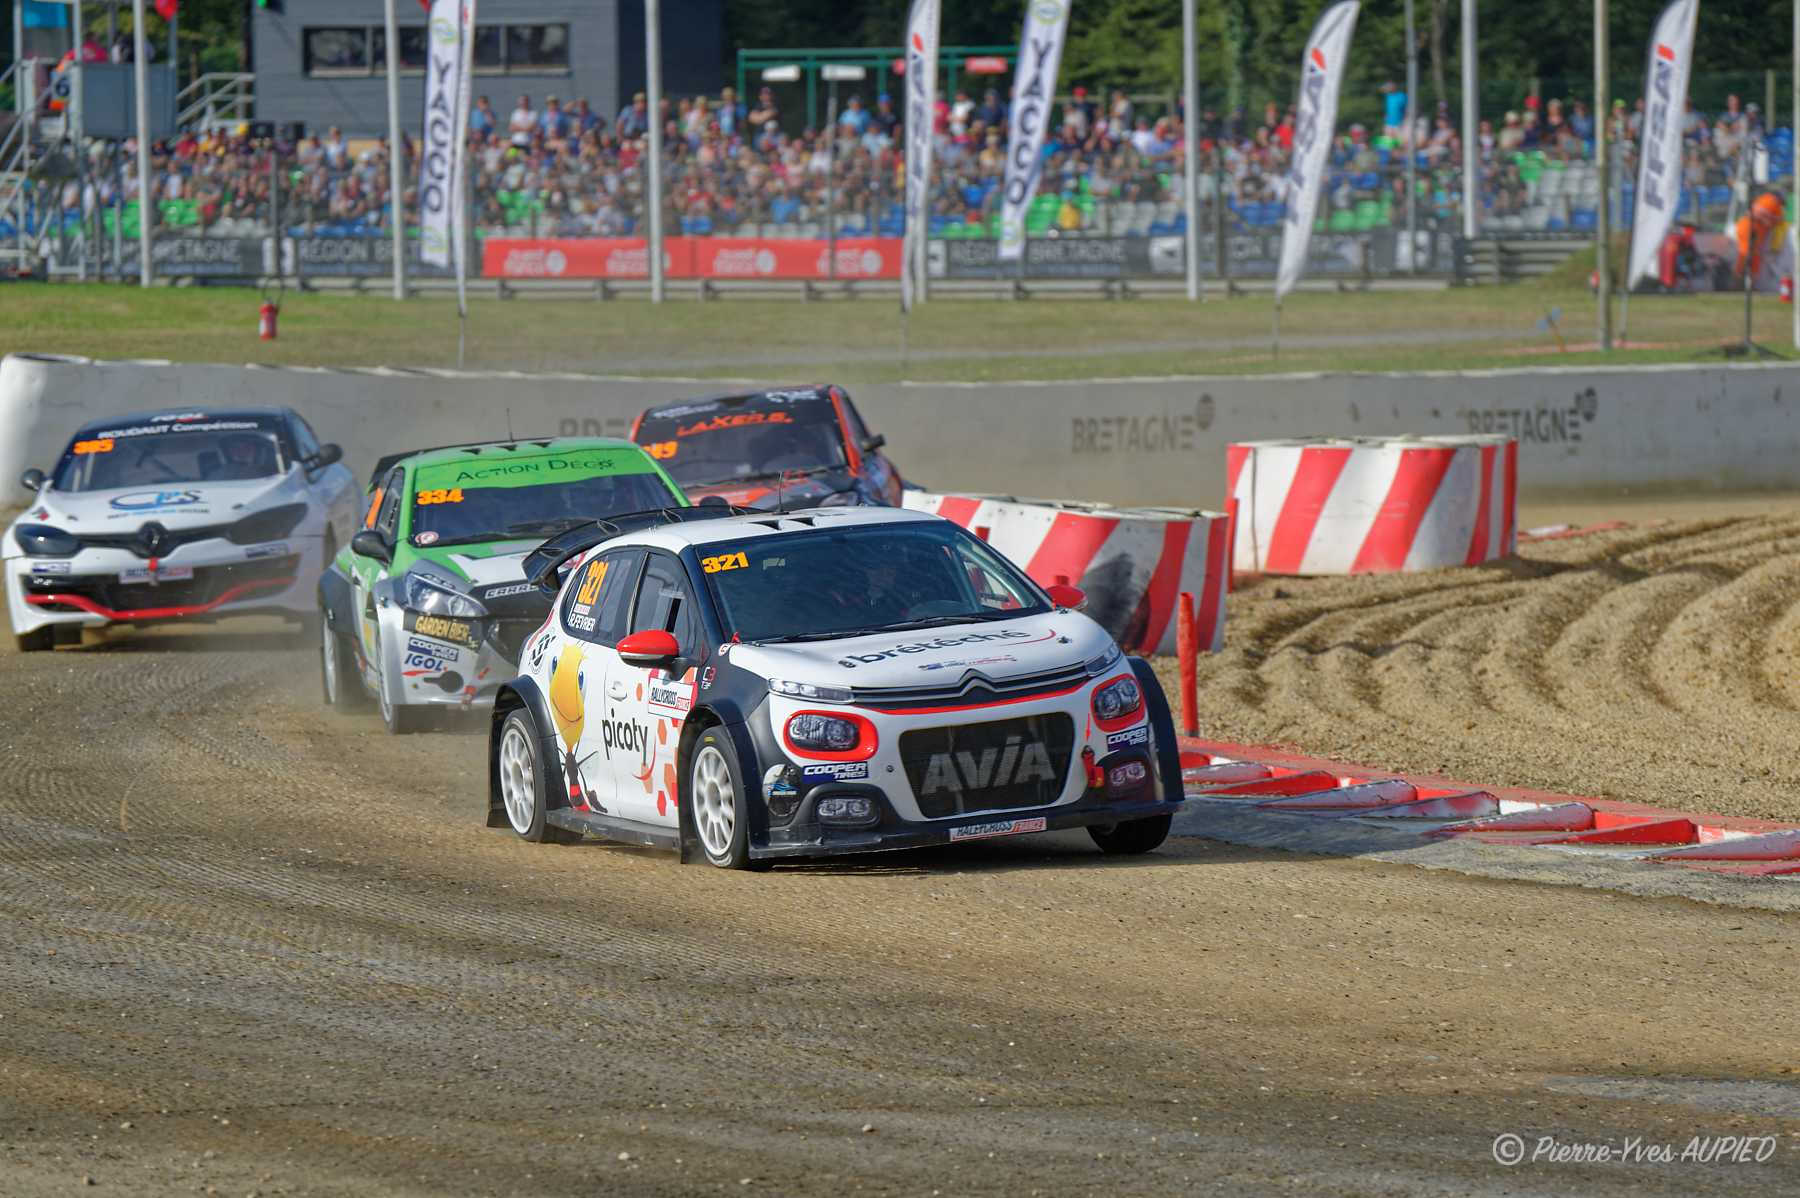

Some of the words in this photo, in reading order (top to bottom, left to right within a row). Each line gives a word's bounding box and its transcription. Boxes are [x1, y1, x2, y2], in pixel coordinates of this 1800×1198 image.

[1006, 37, 1053, 205] YACCO
[424, 54, 453, 214] YACCO
[1071, 415, 1194, 453] BRETAGNE
[456, 463, 540, 482] ACTION
[416, 488, 465, 506] 334
[702, 552, 749, 574] 321
[577, 559, 609, 606] 321
[850, 630, 1031, 664] brétéché
[651, 687, 678, 706] RALLYCROSS
[602, 707, 648, 767] picoty
[1107, 726, 1148, 745] COOPER
[804, 762, 867, 776] COOPER
[833, 770, 866, 780] TIRES
